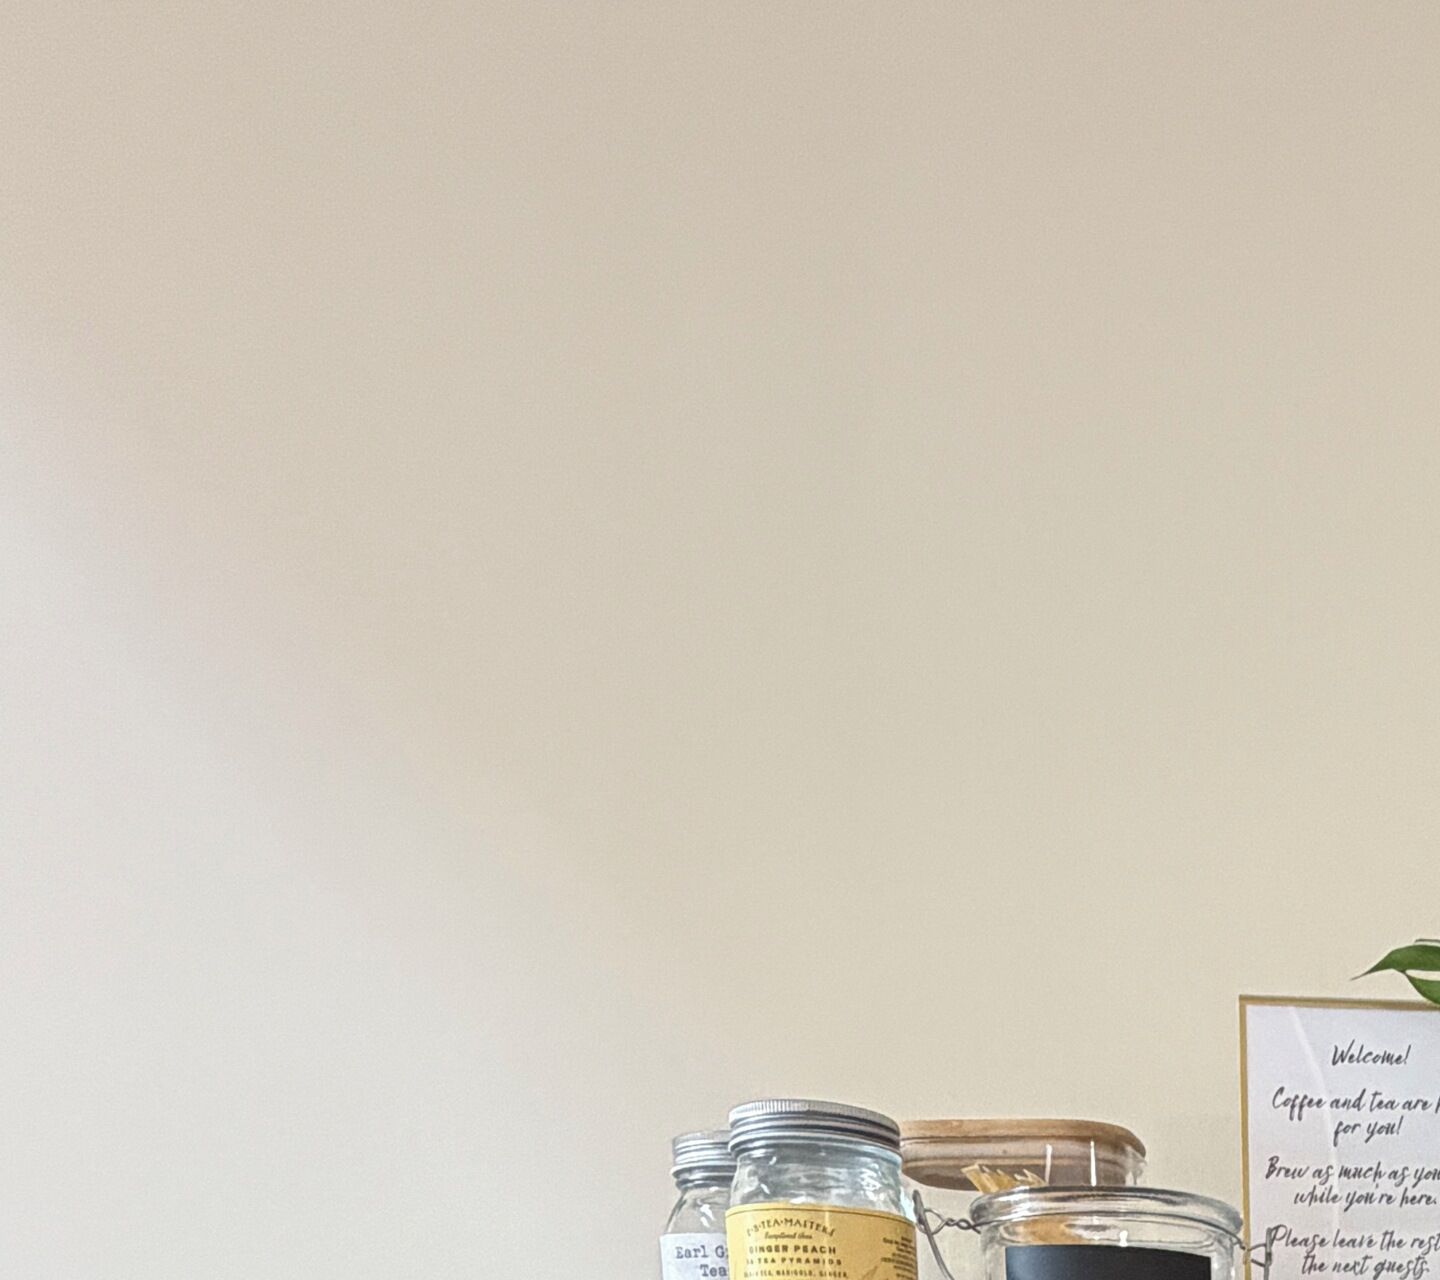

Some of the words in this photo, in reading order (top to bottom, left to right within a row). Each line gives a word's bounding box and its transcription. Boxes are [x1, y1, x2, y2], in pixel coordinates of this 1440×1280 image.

[1331, 1039, 1412, 1067] Welcome!
[1272, 1086, 1326, 1121] Coffee
[1329, 1088, 1366, 1112] and
[1369, 1091, 1400, 1113] tea
[1401, 1098, 1433, 1112] are
[1332, 1120, 1361, 1148] for
[1364, 1115, 1404, 1144] you!
[1265, 1155, 1310, 1179] Brew
[1312, 1164, 1334, 1186] as
[1338, 1161, 1386, 1184] much
[1387, 1165, 1410, 1188] as
[1293, 1184, 1344, 1207] while
[1344, 1183, 1396, 1213] you're
[1399, 1187, 1438, 1208] here.
[675, 1245, 709, 1259] Earl
[749, 1245, 789, 1254] GINGER
[794, 1245, 836, 1254] PEACH
[1271, 1224, 1330, 1254] Please
[1332, 1229, 1378, 1250] leave
[1379, 1230, 1407, 1251] the
[700, 1264, 727, 1277] Tea
[781, 1257, 842, 1266] PYRAMIDS
[1301, 1253, 1328, 1275] the
[1332, 1255, 1374, 1275] next
[1373, 1255, 1430, 1280] guests.
